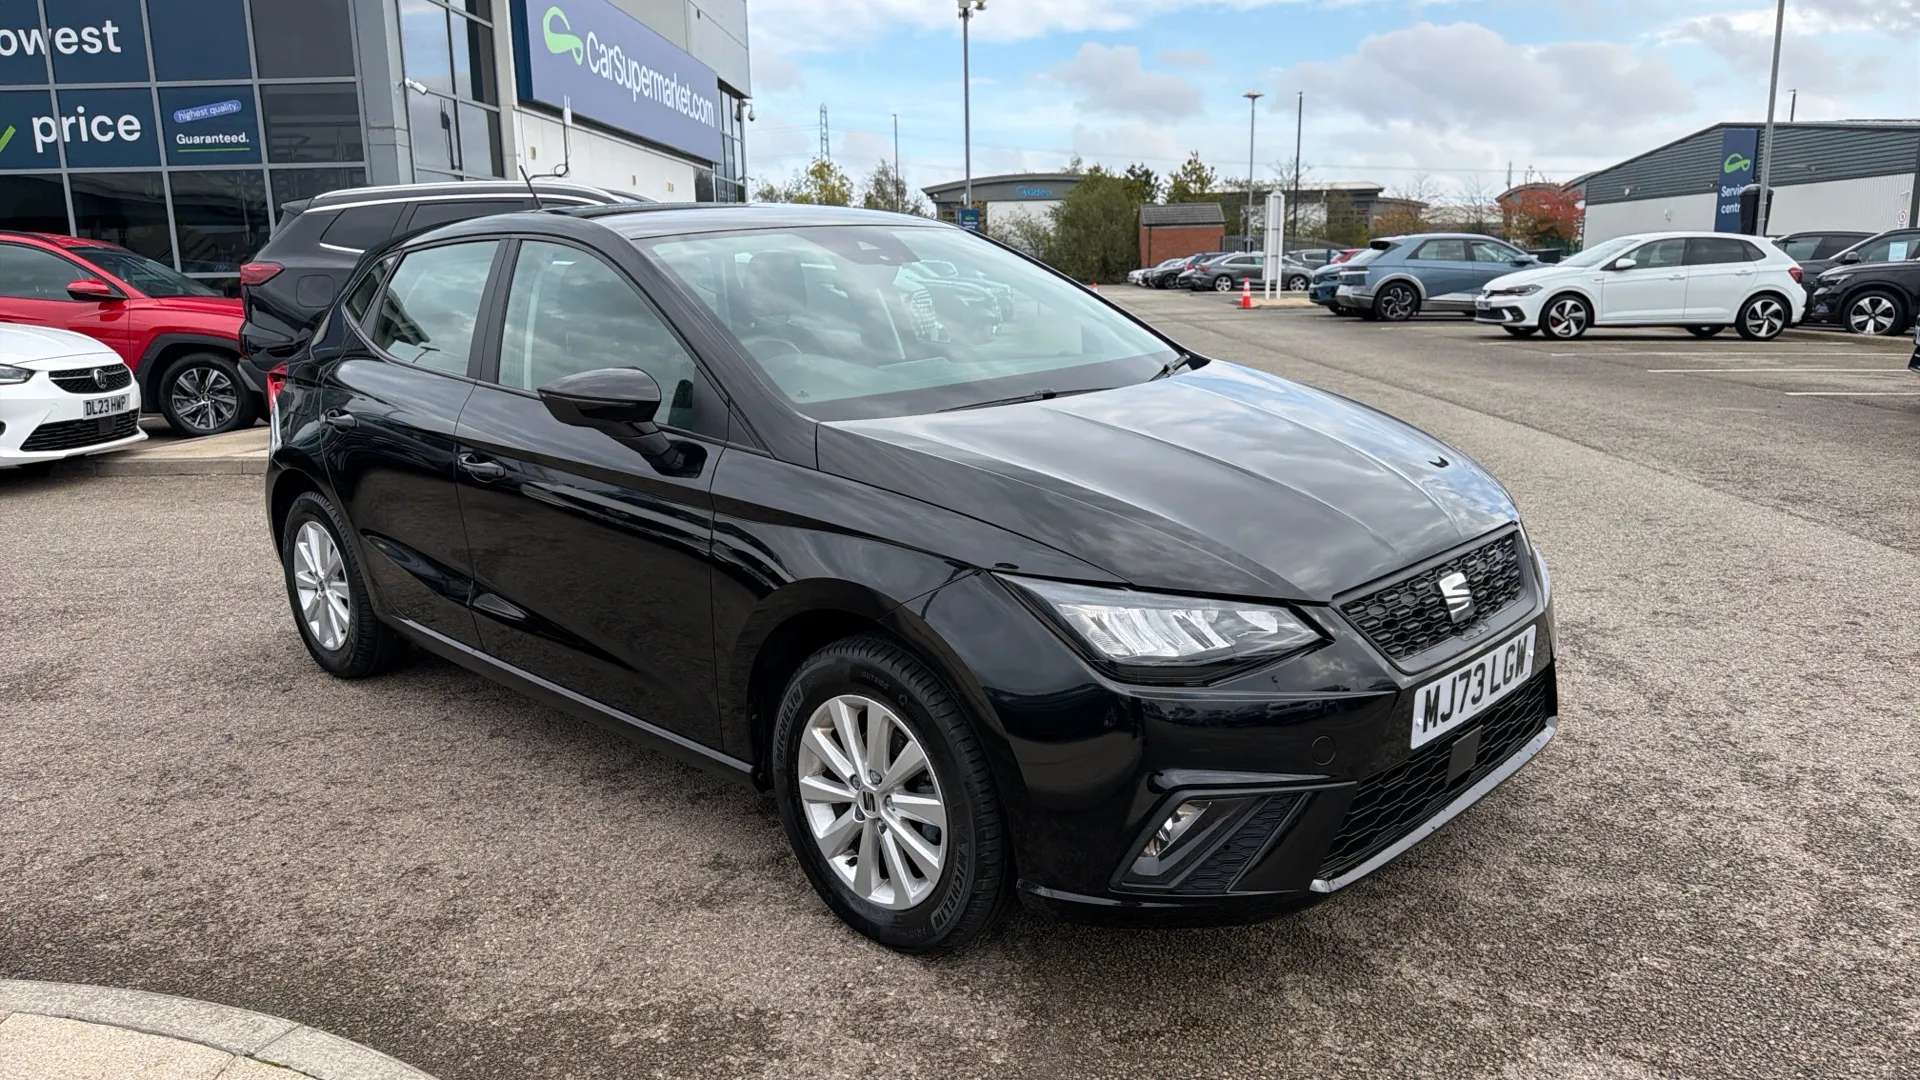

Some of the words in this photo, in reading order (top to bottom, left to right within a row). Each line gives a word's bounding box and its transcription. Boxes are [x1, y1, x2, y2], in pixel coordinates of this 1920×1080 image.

[586, 31, 715, 128] CarSupermarket.com
[177, 108, 208, 121] highest
[32, 105, 141, 153] price
[176, 131, 250, 145] Guaranteed.
[1721, 184, 1744, 198] Servic
[1721, 203, 1740, 214] centr
[86, 400, 109, 415] DL23
[1423, 662, 1486, 734] MJ73
[1489, 635, 1529, 696] LGW
